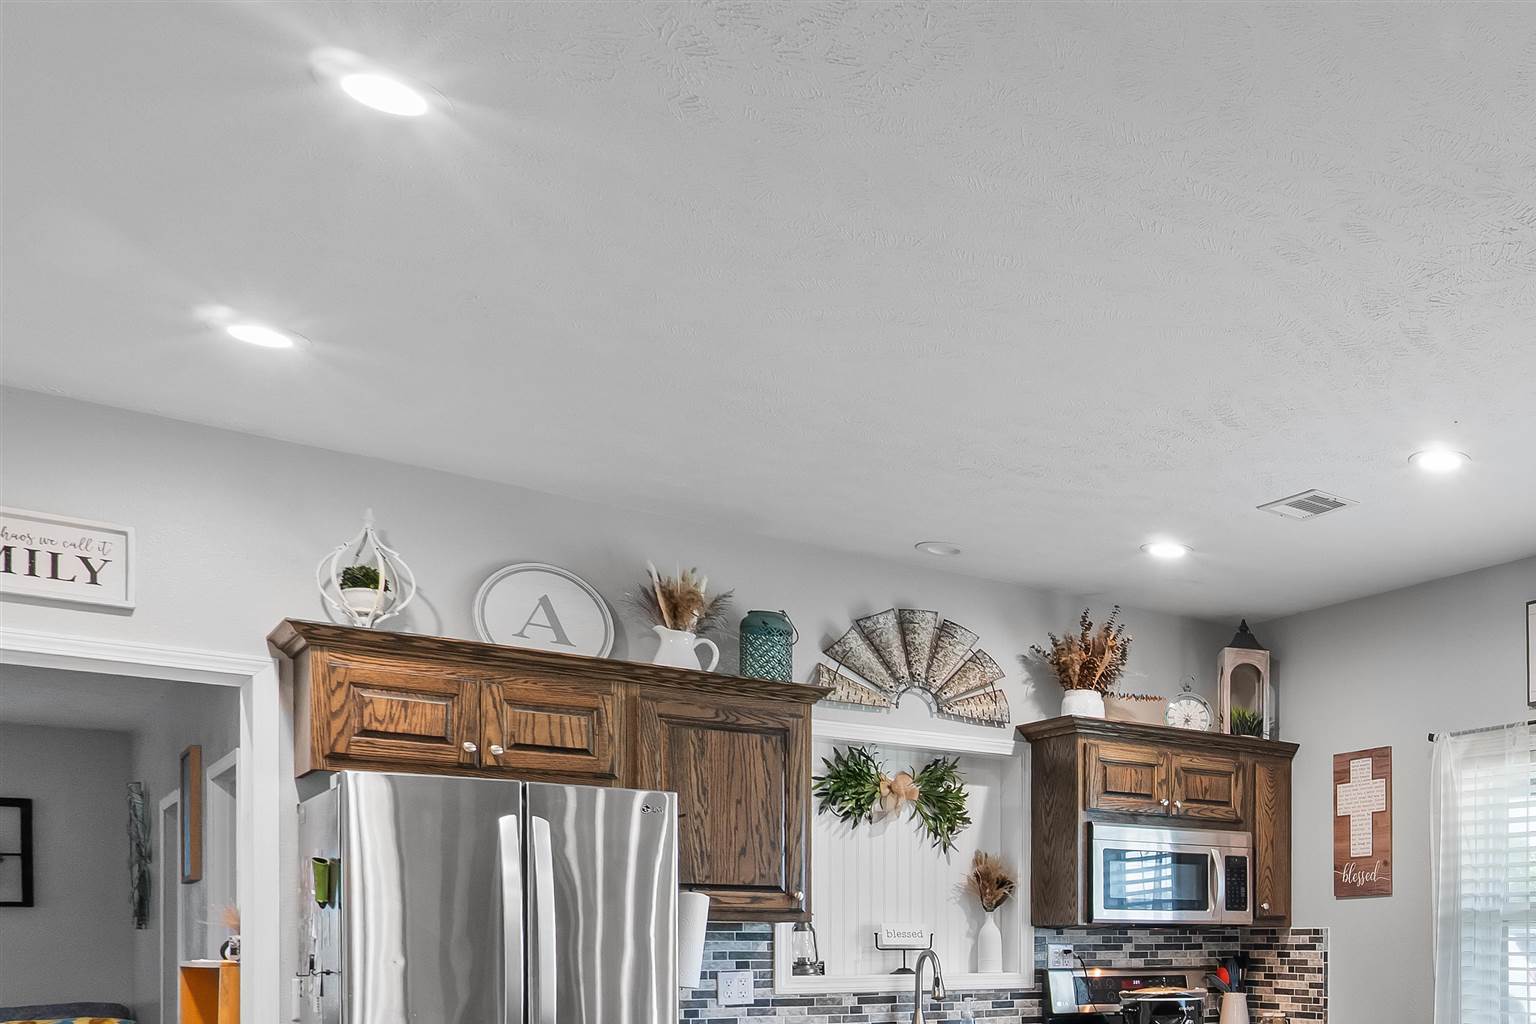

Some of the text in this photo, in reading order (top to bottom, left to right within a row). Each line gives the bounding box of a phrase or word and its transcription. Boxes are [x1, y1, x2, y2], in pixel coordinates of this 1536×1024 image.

[39, 536, 57, 546] we
[62, 537, 93, 552] call
[97, 541, 113, 556] it
[512, 594, 577, 648] A
[1335, 860, 1389, 887] blessed
[886, 929, 924, 939] blessed
